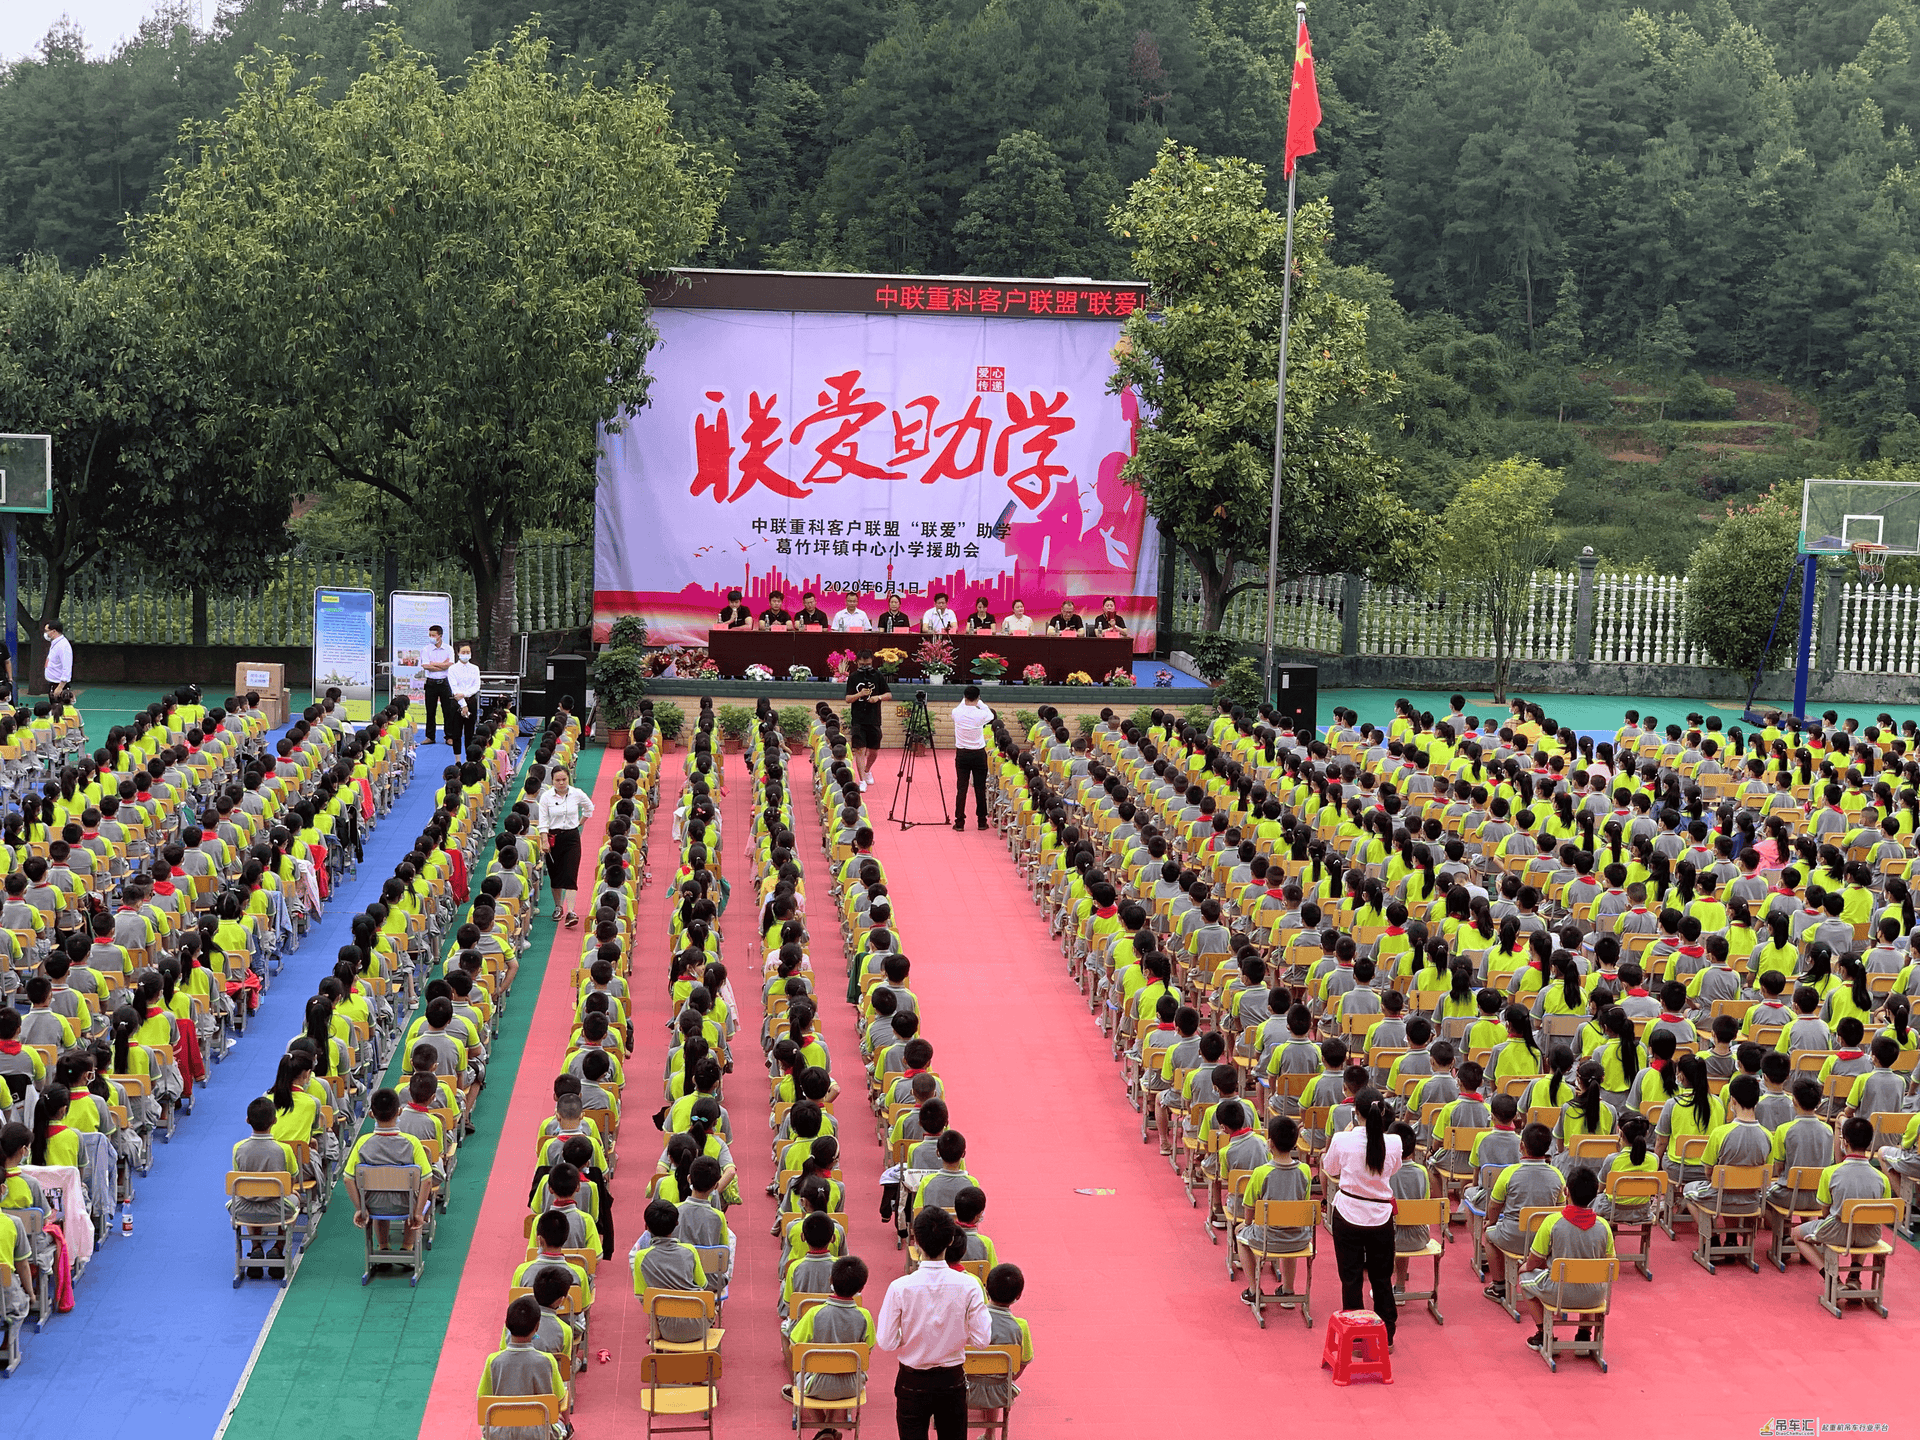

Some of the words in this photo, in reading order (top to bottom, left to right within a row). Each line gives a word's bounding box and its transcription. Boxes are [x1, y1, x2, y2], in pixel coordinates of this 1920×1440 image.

[876, 284, 1145, 316] 中联重科客户联盟“联爱
[977, 367, 1004, 379] 爱心
[977, 380, 1004, 392] 传递
[690, 370, 1076, 510] 联爱助学
[752, 517, 1011, 539] 中联重科客户联盟“联爱”助学
[776, 538, 980, 558] 葛竹坪镇中心小学援助会
[824, 580, 919, 595] 2020年6月1日
